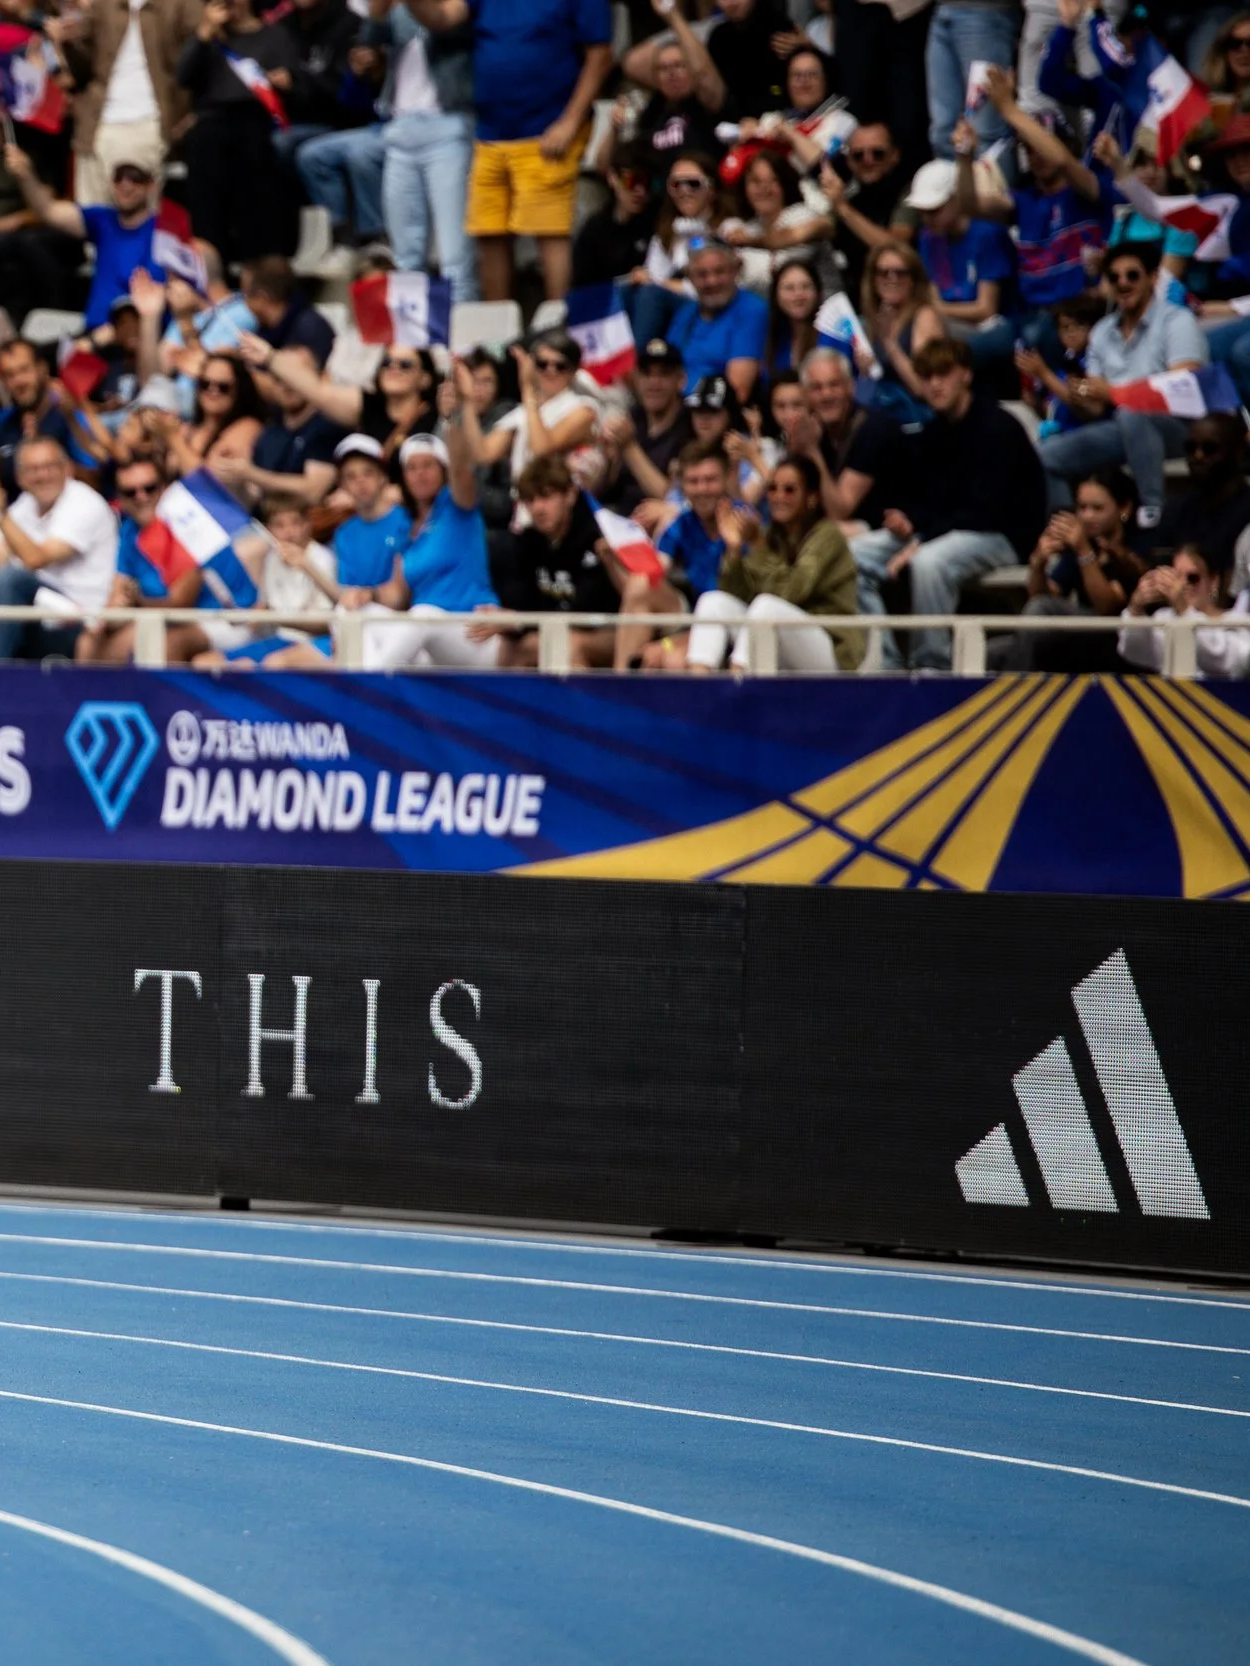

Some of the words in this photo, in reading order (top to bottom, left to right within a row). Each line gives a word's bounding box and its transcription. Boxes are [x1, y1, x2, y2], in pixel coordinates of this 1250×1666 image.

[256, 721, 351, 759] WANDA
[161, 768, 366, 831] DIAMOND
[372, 771, 546, 836] LEAGUE
[134, 967, 483, 1110] THIS
